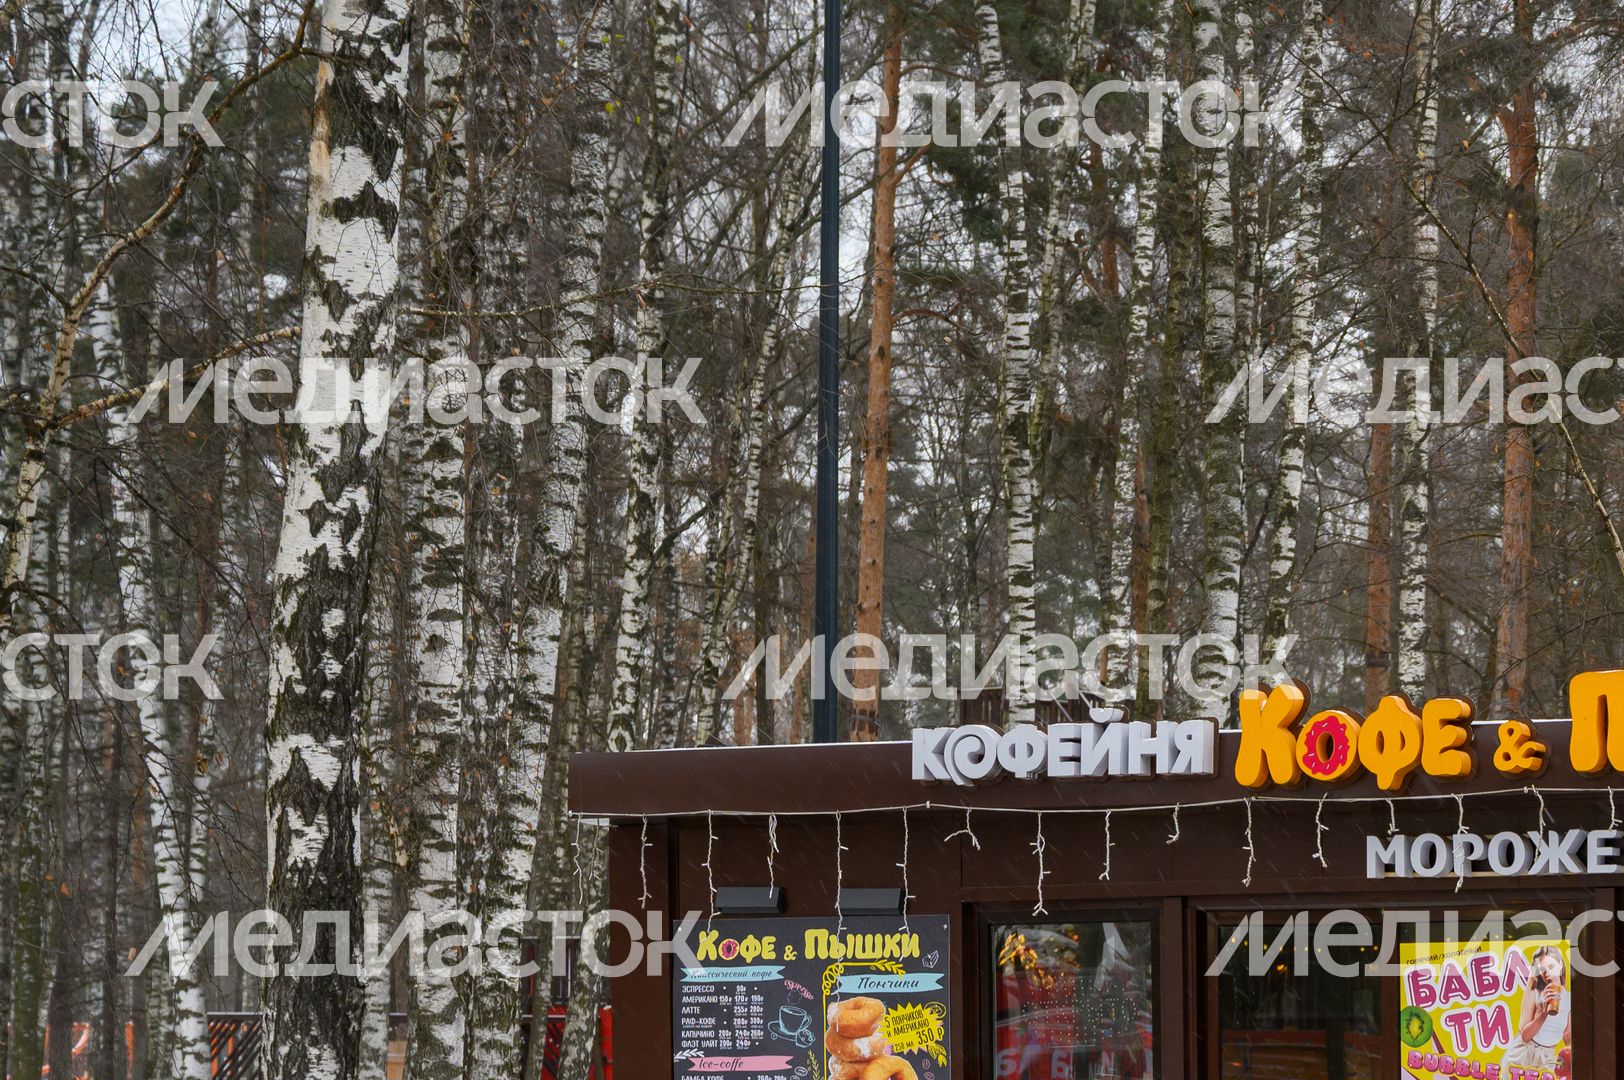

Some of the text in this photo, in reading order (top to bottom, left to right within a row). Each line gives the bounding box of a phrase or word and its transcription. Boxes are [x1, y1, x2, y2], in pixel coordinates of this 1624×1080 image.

[912, 707, 1214, 787] КОФЕЙНЯ
[1493, 719, 1546, 774] &
[784, 945, 798, 960] &
[857, 977, 920, 990] Пончики
[1406, 949, 1531, 1010] БАБЛ
[885, 1009, 924, 1029] 5 ПОНЧИКОВ
[894, 1018, 930, 1036] АМЕРИКАНО
[1444, 1004, 1510, 1054] ТИ
[682, 1040, 718, 1048] ФЛЭТ УАЙТ
[895, 1028, 935, 1051] 250 350
